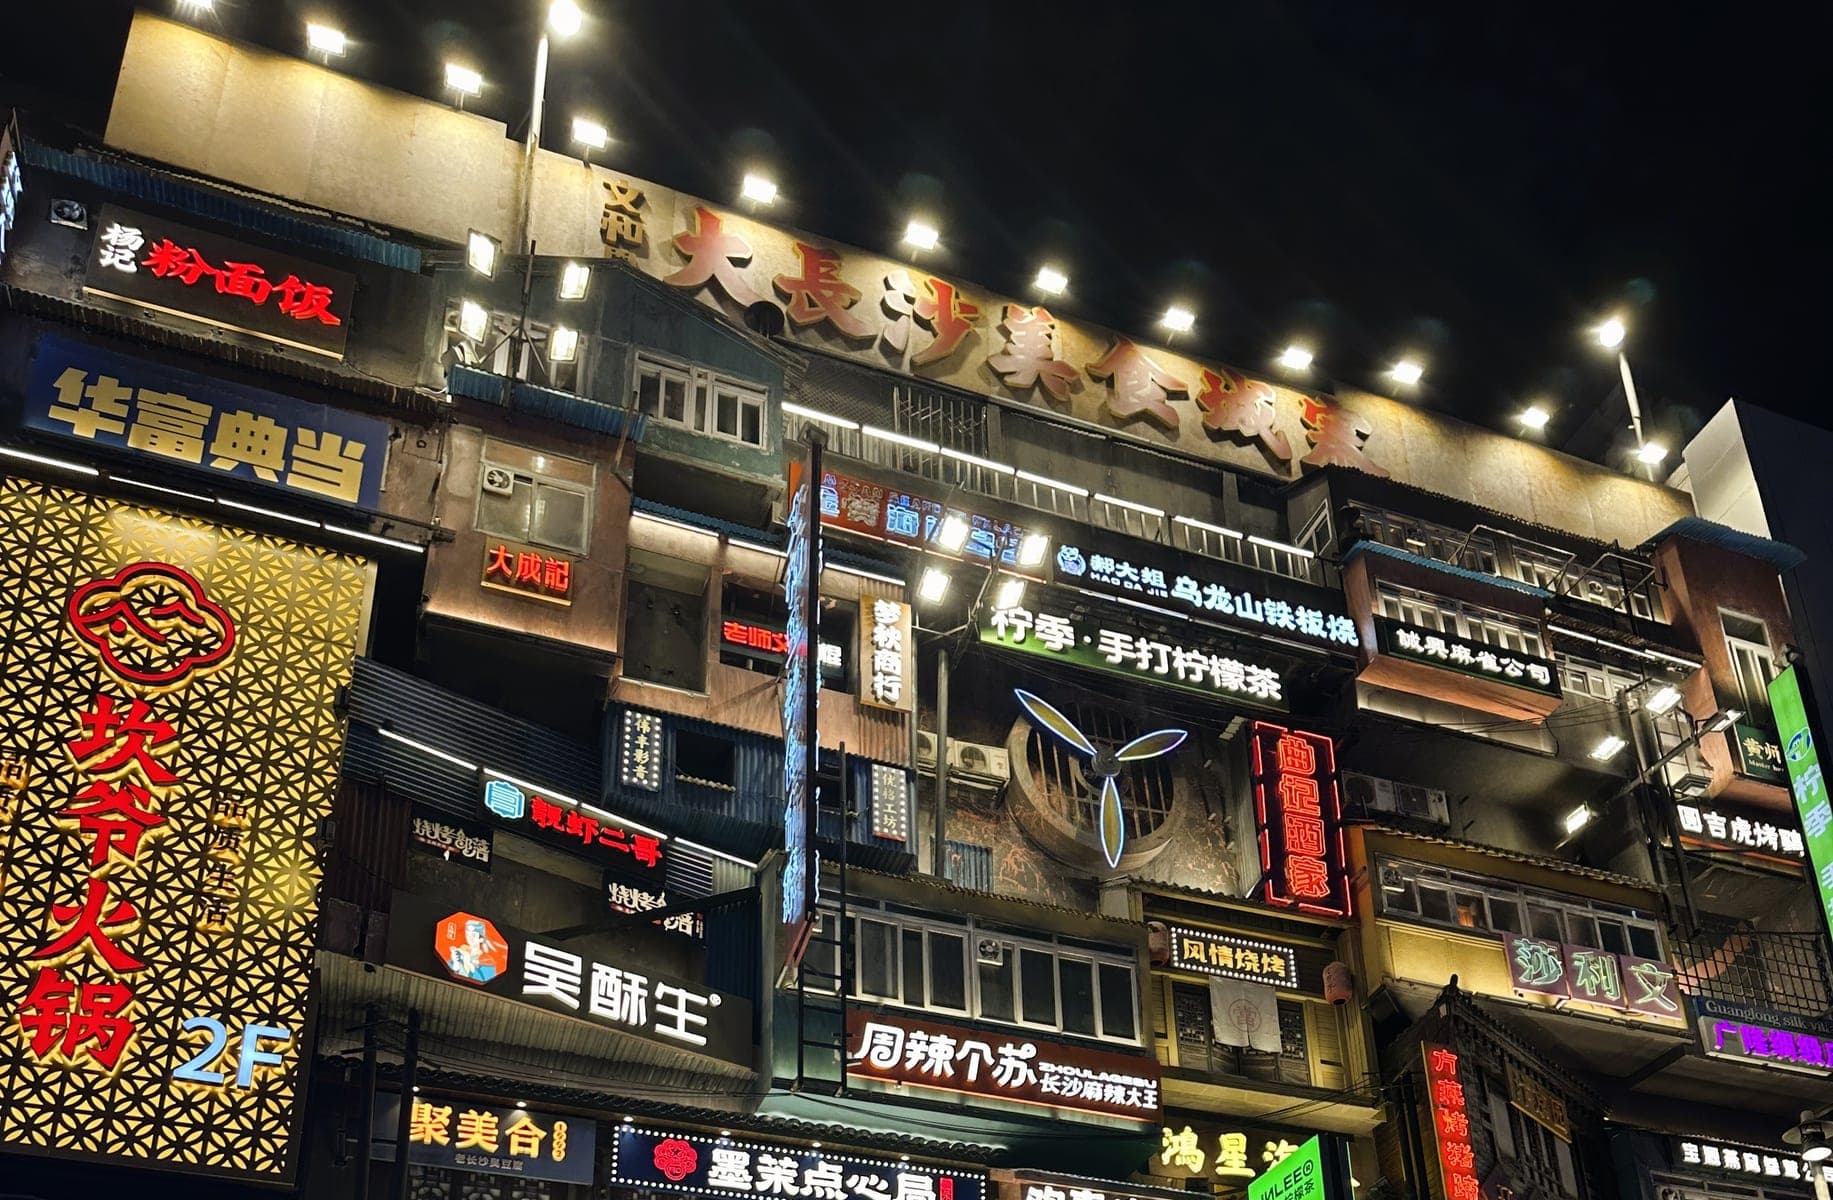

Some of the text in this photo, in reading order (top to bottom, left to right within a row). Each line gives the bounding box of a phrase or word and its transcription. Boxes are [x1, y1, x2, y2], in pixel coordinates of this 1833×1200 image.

[100, 223, 145, 273] 杨记
[142, 239, 342, 326] 粉面饭
[48, 367, 366, 502] 华富典当
[486, 545, 570, 593] 大成記
[1090, 554, 1360, 648] 郝大姐 乌龙山铁板烧
[1279, 734, 1331, 899] 曲记酒家
[16, 694, 182, 1072] 坎爷火锅
[200, 792, 250, 926] 品质生活
[1182, 937, 1287, 978] 风情烧烤
[1512, 937, 1679, 1013] 莎利文
[1705, 1000, 1782, 1028] Guanglong
[173, 1017, 291, 1088] 2F
[1039, 1073, 1158, 1110] 长沙麻辣大王
[409, 1102, 548, 1159] 聚美合
